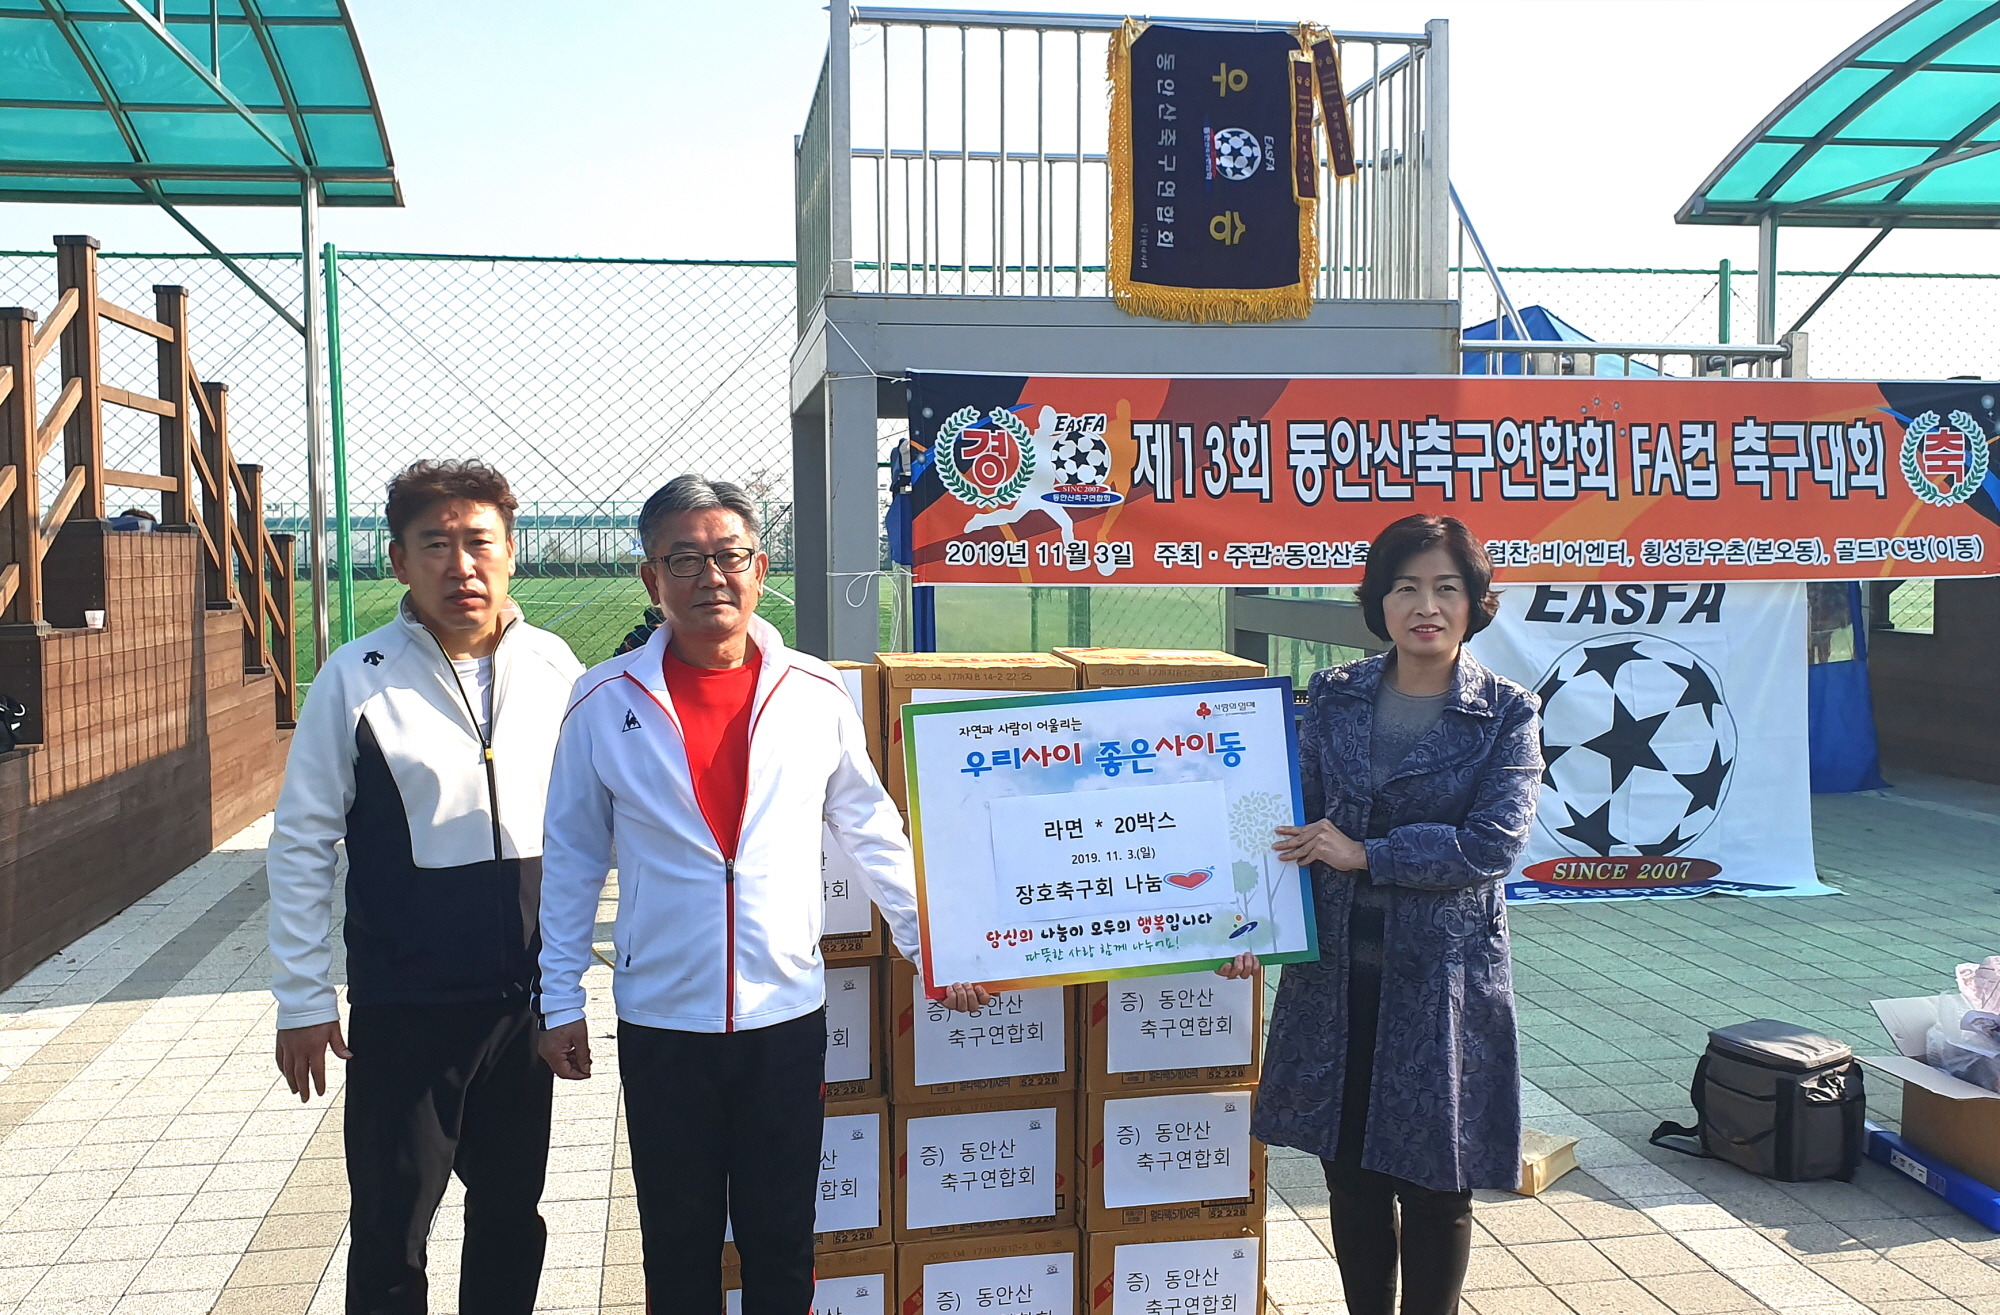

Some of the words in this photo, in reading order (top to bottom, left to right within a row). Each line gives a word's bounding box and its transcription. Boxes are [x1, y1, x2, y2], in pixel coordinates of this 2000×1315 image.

[1212, 62, 1248, 97] 우
[1156, 53, 1177, 248] 동안산축구연합회
[1210, 210, 1246, 245] 승
[961, 428, 1009, 488] 경
[1132, 418, 1271, 501] 제13회
[1288, 417, 1617, 502] 동안산축구연합회
[1629, 420, 1719, 500] FA컵
[1732, 417, 1886, 500] 축구대회
[1923, 427, 1964, 483] 축
[1052, 494, 1111, 502] 동안산축구연합회
[947, 542, 1026, 565] 2019년
[1037, 542, 1087, 565] 11월
[1096, 543, 1131, 565] 3일
[1156, 543, 1200, 566] 주최
[1226, 543, 1371, 566] 주관:동안산축
[1836, 537, 1983, 562] 골드PC방(이동)
[1524, 582, 1727, 624] EASFA
[959, 724, 994, 739] 자연과
[998, 721, 1032, 736] 사람이
[1037, 717, 1082, 733] 어울리는
[960, 742, 1081, 777] 우리사이
[1095, 732, 1246, 777] 좋은사이동
[1044, 818, 1084, 841] 라면
[1114, 812, 1177, 834] 20박스
[1071, 854, 1101, 865] 2019.
[1106, 851, 1122, 862] 11.
[1127, 846, 1156, 860] 3.(일)
[1552, 863, 1629, 881] SINCE
[1638, 862, 1691, 880] 2007
[1015, 876, 1114, 905] 장호축구회
[1125, 873, 1162, 895] 나눔
[986, 928, 1033, 948] 당신의
[1041, 924, 1084, 942] 나눔이
[1091, 919, 1131, 935] 모두의
[1137, 913, 1213, 934] 행복입니다
[1025, 947, 1064, 963] 따뜻한
[1069, 945, 1095, 958] 사랑
[1100, 942, 1127, 956] 함께
[1120, 992, 1144, 1013] 증)
[1159, 988, 1214, 1010] 동안산
[948, 1021, 1044, 1048] 축구연합회
[1140, 1015, 1232, 1039] 축구연합회
[1116, 1125, 1140, 1146] 증)
[1155, 1121, 1211, 1143] 동안산
[920, 1145, 945, 1167] 증)
[959, 1138, 1016, 1162] 동안산
[1136, 1147, 1230, 1172] 축구연합회
[940, 1166, 1035, 1192] 축구연합회
[1126, 1272, 1150, 1292] 증)
[1164, 1267, 1219, 1289] 동안산
[936, 1291, 961, 1311] 증)
[976, 1284, 1033, 1307] 동안산
[1146, 1293, 1237, 1315] 축구연합회
